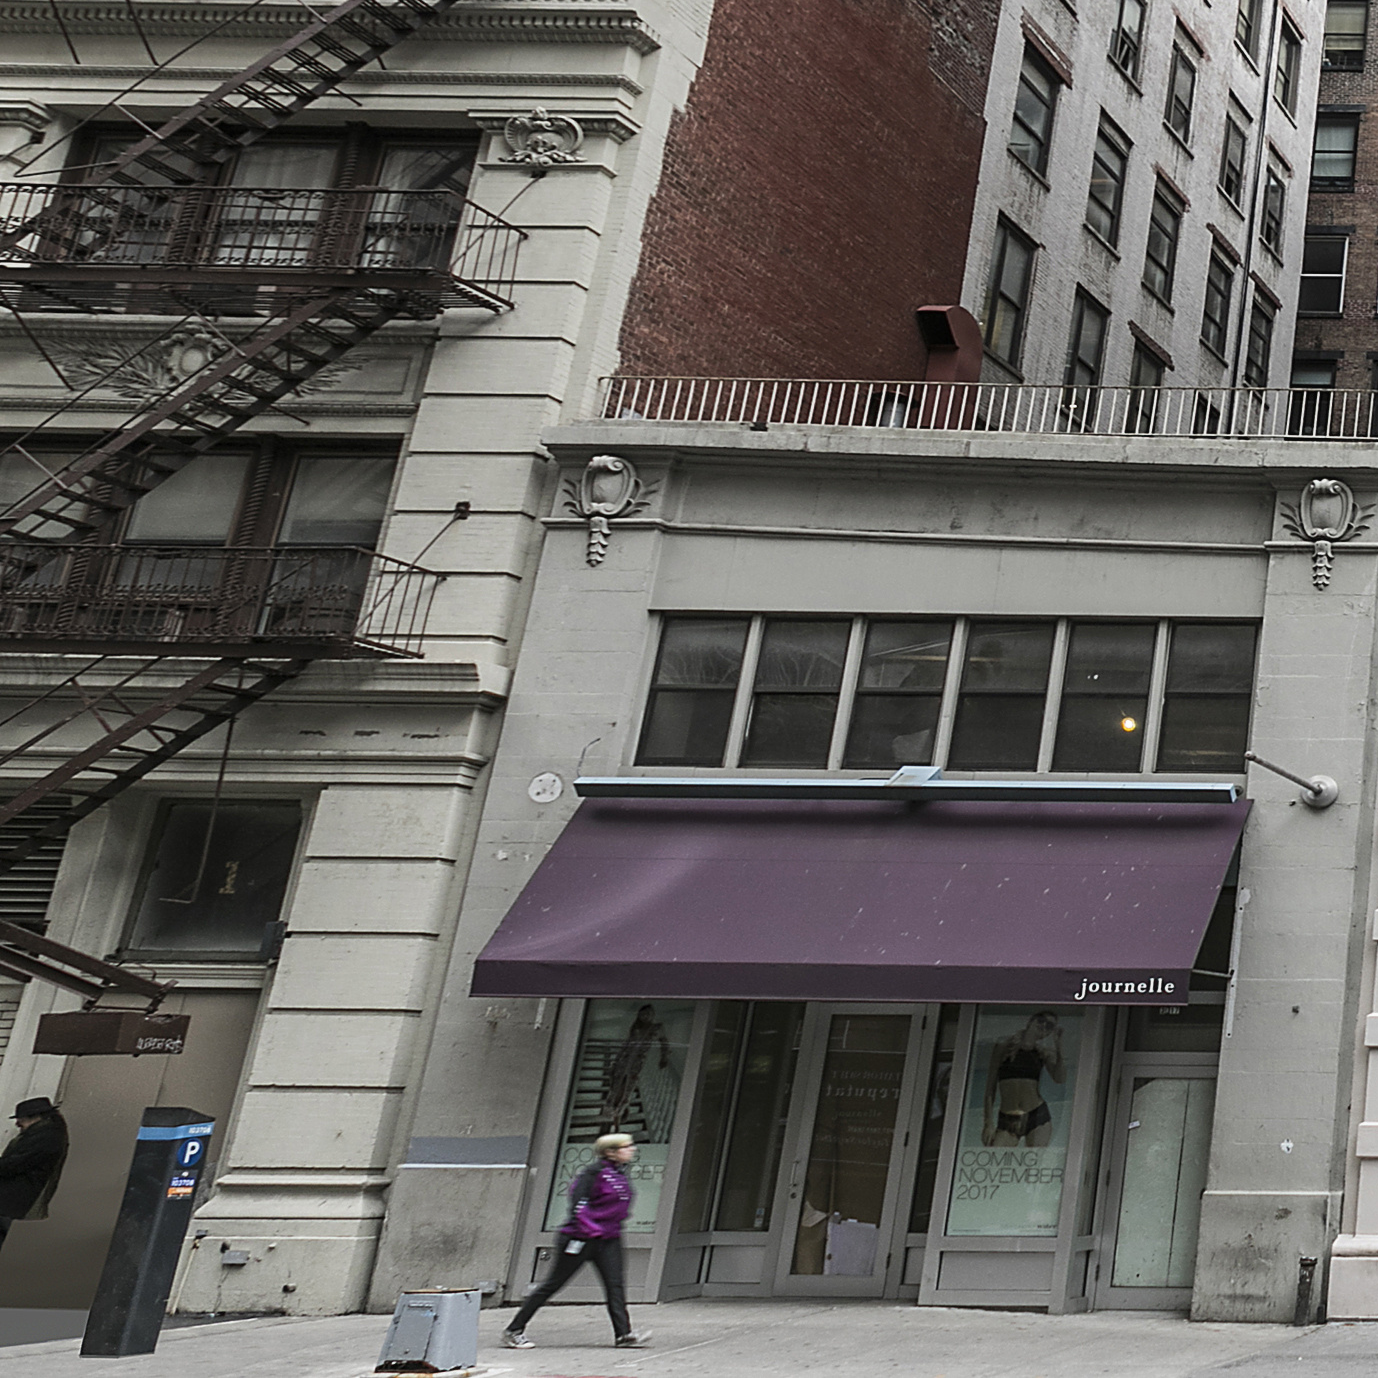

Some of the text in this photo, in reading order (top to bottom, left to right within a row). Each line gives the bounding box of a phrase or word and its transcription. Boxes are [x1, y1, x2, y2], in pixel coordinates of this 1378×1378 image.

[1074, 977, 1175, 1000] journelle
[184, 1141, 200, 1164] P
[962, 1150, 1038, 1167] COMING
[959, 1167, 1064, 1183] NOVEMBER
[956, 1184, 1000, 1200] 2017
